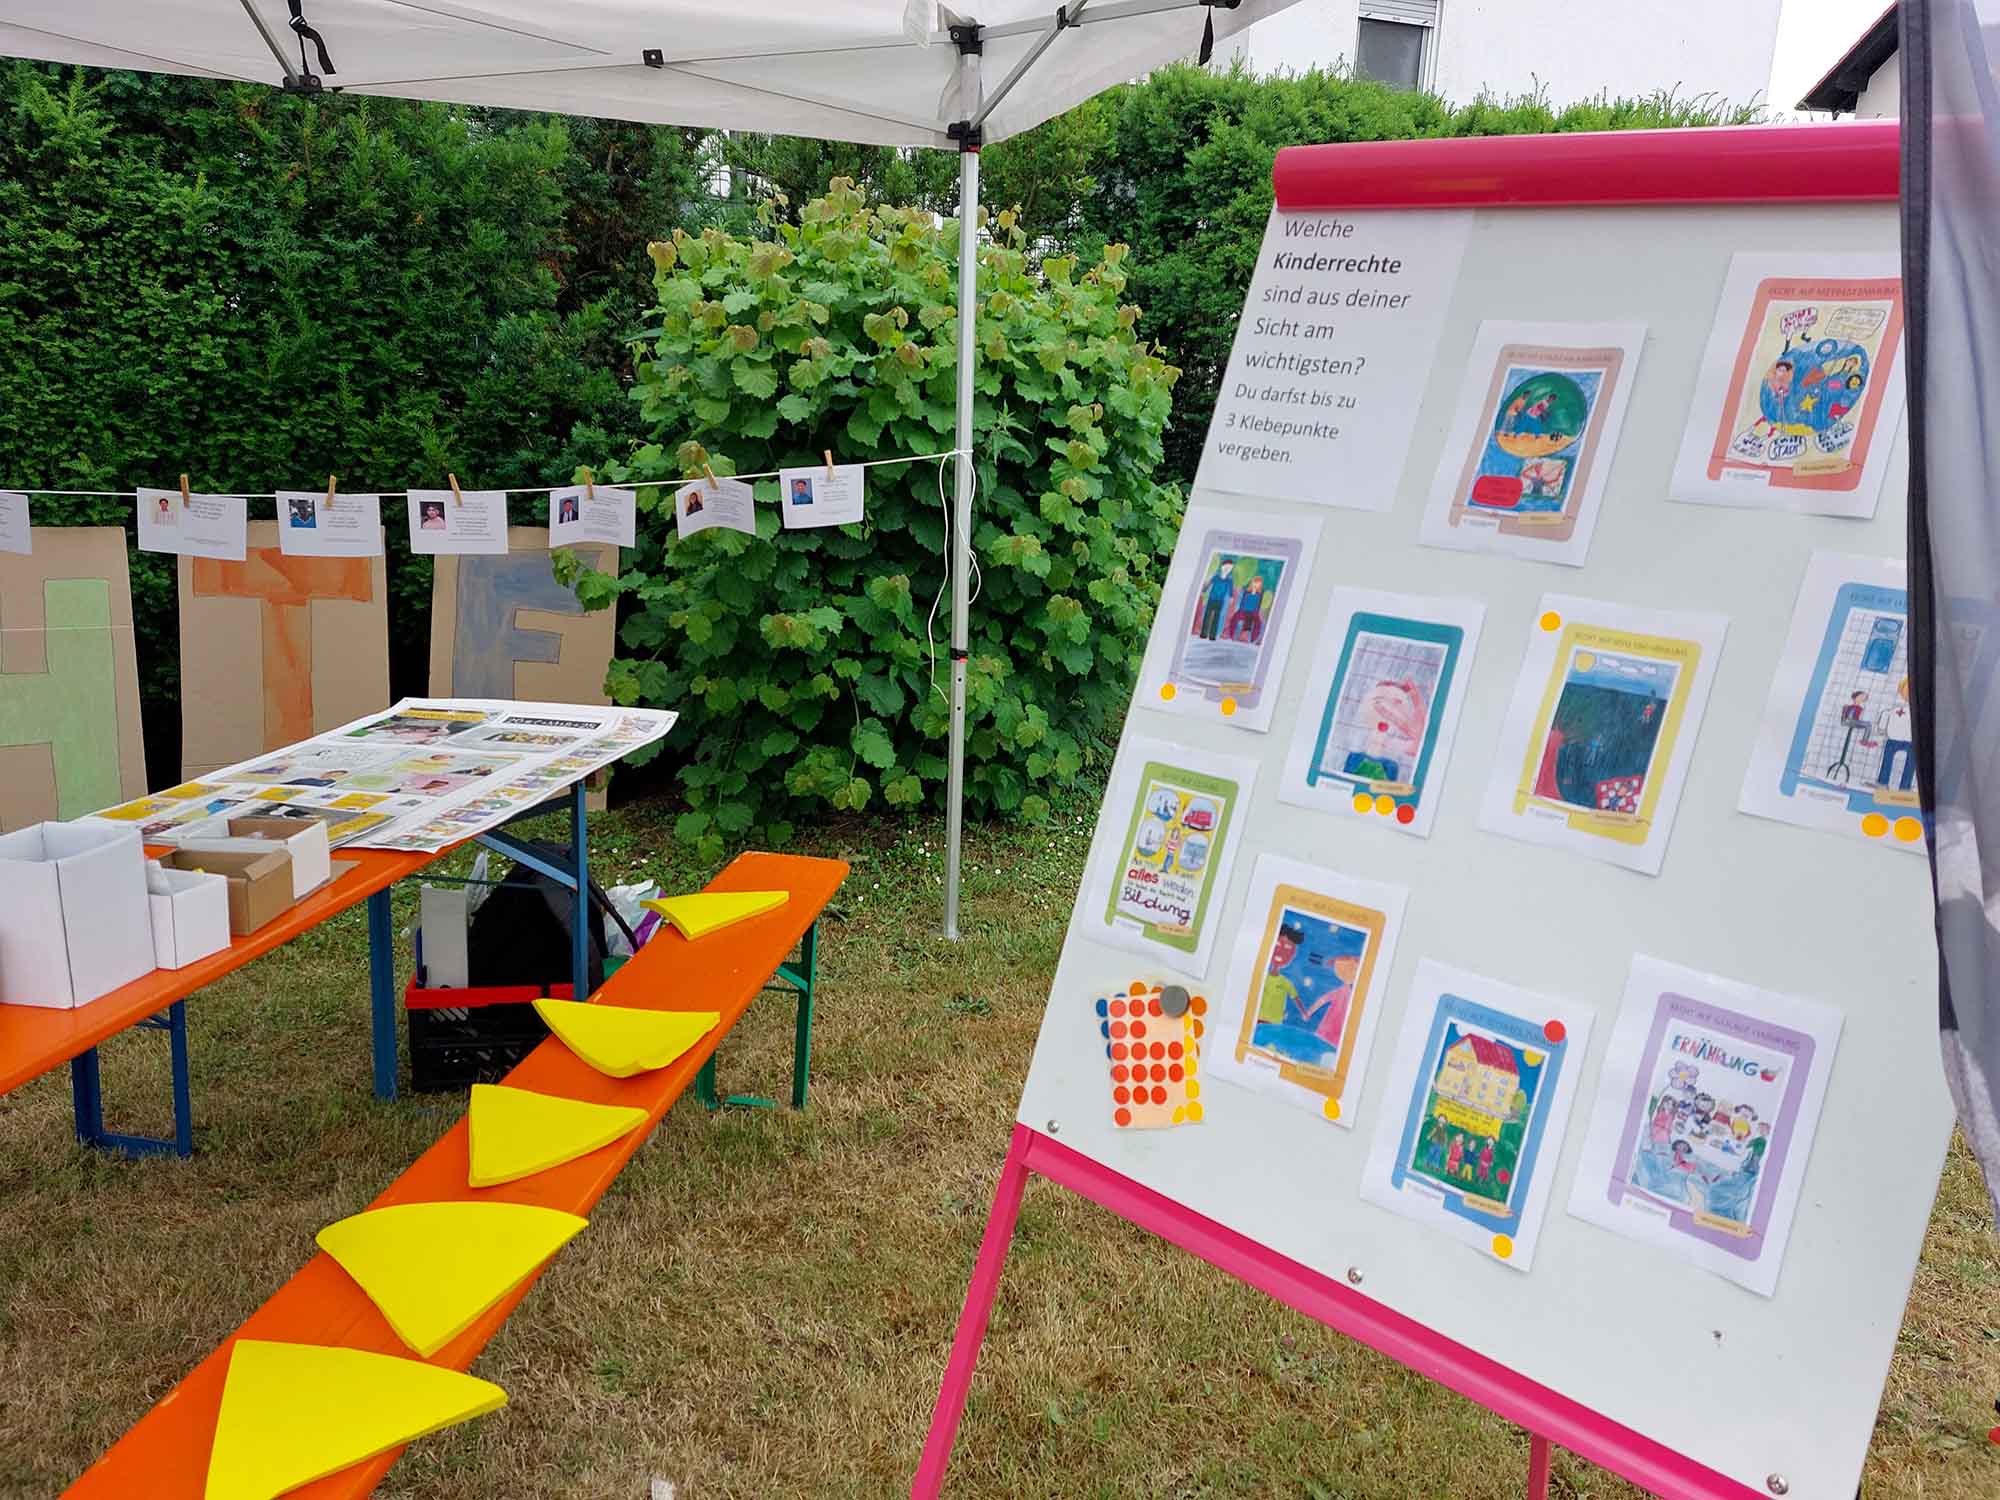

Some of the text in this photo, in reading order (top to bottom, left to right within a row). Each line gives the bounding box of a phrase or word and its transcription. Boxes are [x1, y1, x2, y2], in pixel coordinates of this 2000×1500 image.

[1285, 220, 1354, 238] Welche
[1273, 252, 1401, 274] Kinderrechte
[1263, 285, 1411, 309] sind aus deiner
[1254, 317, 1334, 340] Sicht am
[1246, 351, 1365, 376] wichtigsten?
[1235, 383, 1356, 409] Du darfst bis zu
[1226, 413, 1339, 440] 3 Klebepunkte
[1218, 442, 1293, 464] vergeben.
